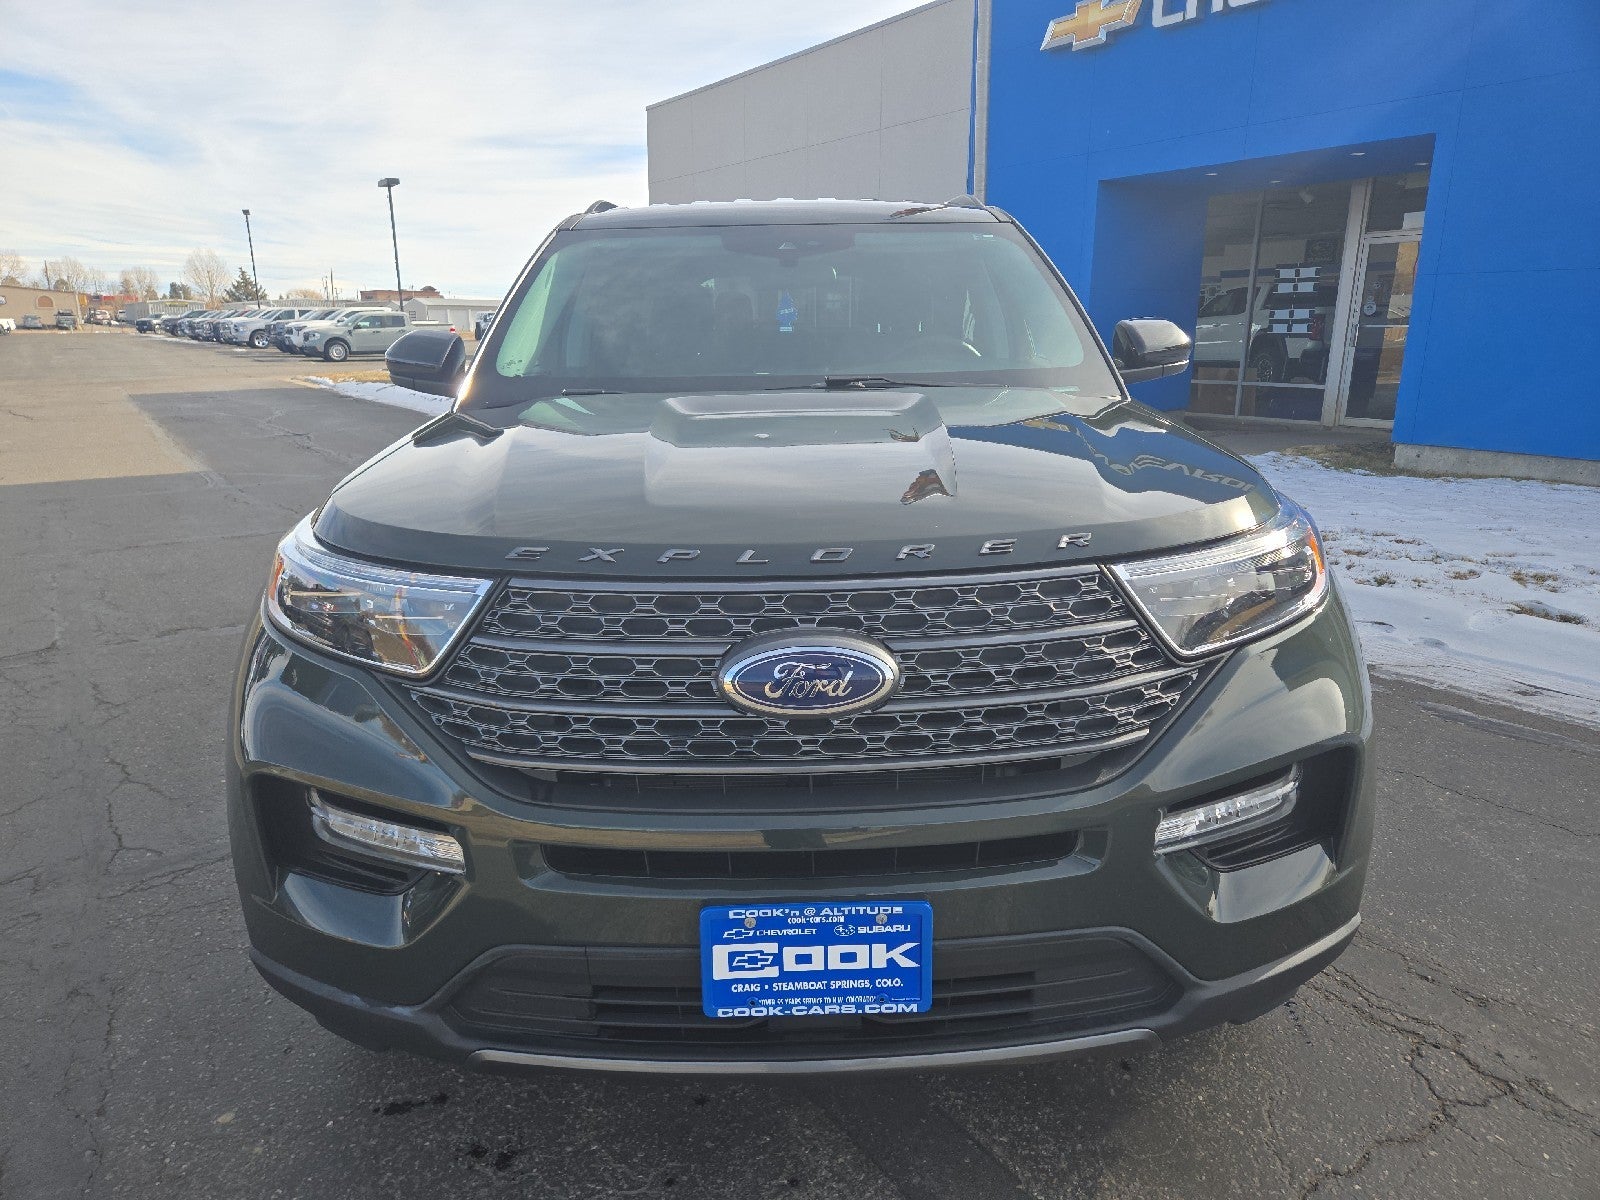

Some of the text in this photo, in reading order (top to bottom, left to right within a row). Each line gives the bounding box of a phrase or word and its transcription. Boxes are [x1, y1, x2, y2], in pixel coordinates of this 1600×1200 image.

[504, 532, 1093, 563] EXPLORER
[764, 661, 854, 699] Ford
[820, 906, 903, 916] ALTITUDE
[787, 915, 845, 924] cook-cars.com
[756, 928, 817, 936] CHEVROLET
[857, 924, 911, 934] SUBARU
[712, 942, 921, 980] COOK
[731, 977, 904, 992] CRAIG STEAMBOAT SPRINGS, COLO.
[717, 1003, 918, 1018] COOK-CARS.COM
